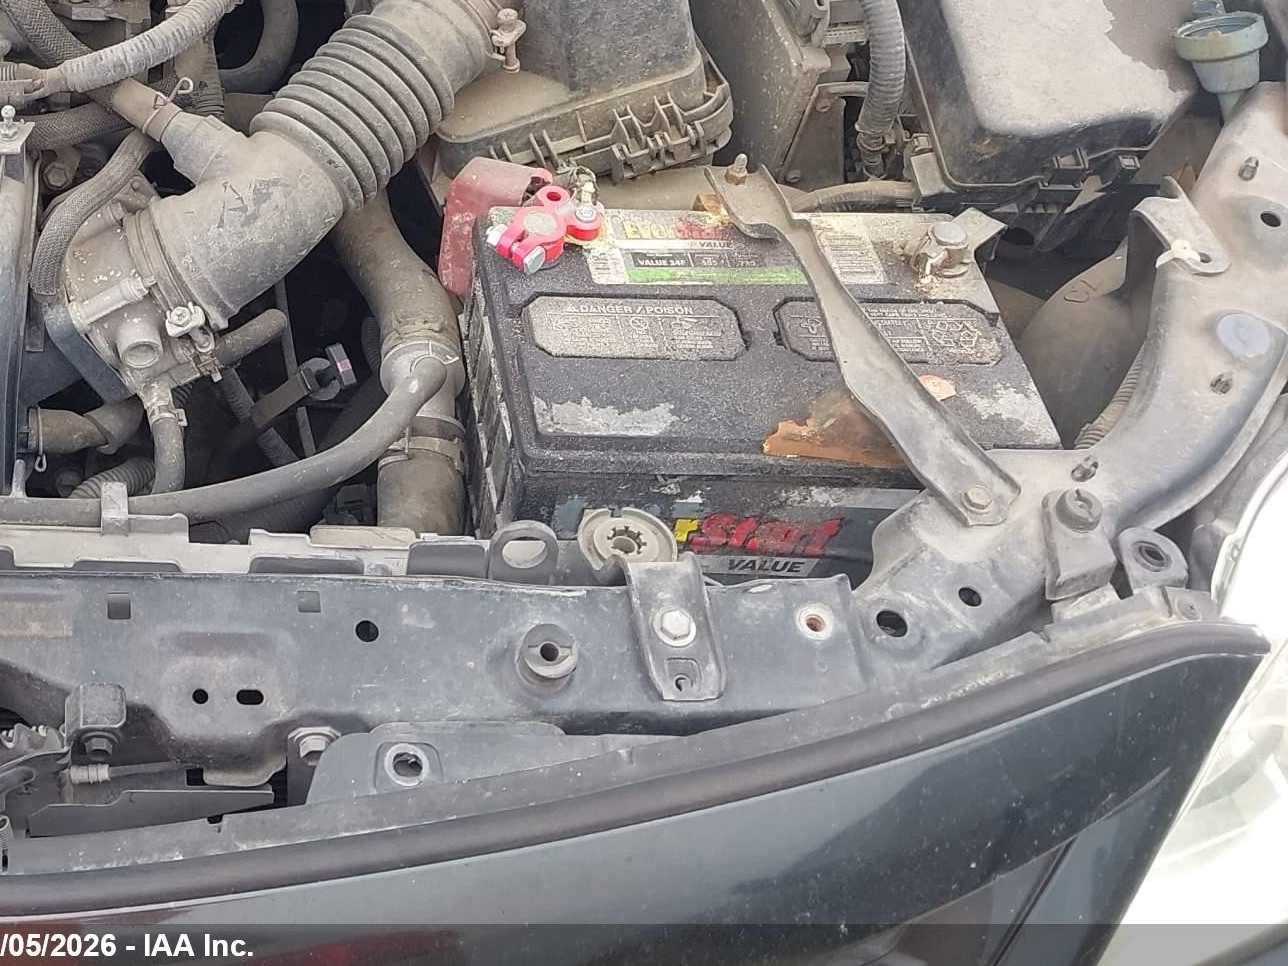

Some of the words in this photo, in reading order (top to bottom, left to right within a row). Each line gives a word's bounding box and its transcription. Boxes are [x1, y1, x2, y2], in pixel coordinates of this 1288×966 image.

[637, 258, 668, 267] VALUE
[579, 305, 633, 315] DANGER
[647, 306, 695, 316] POISON
[727, 558, 805, 573] VALUE
